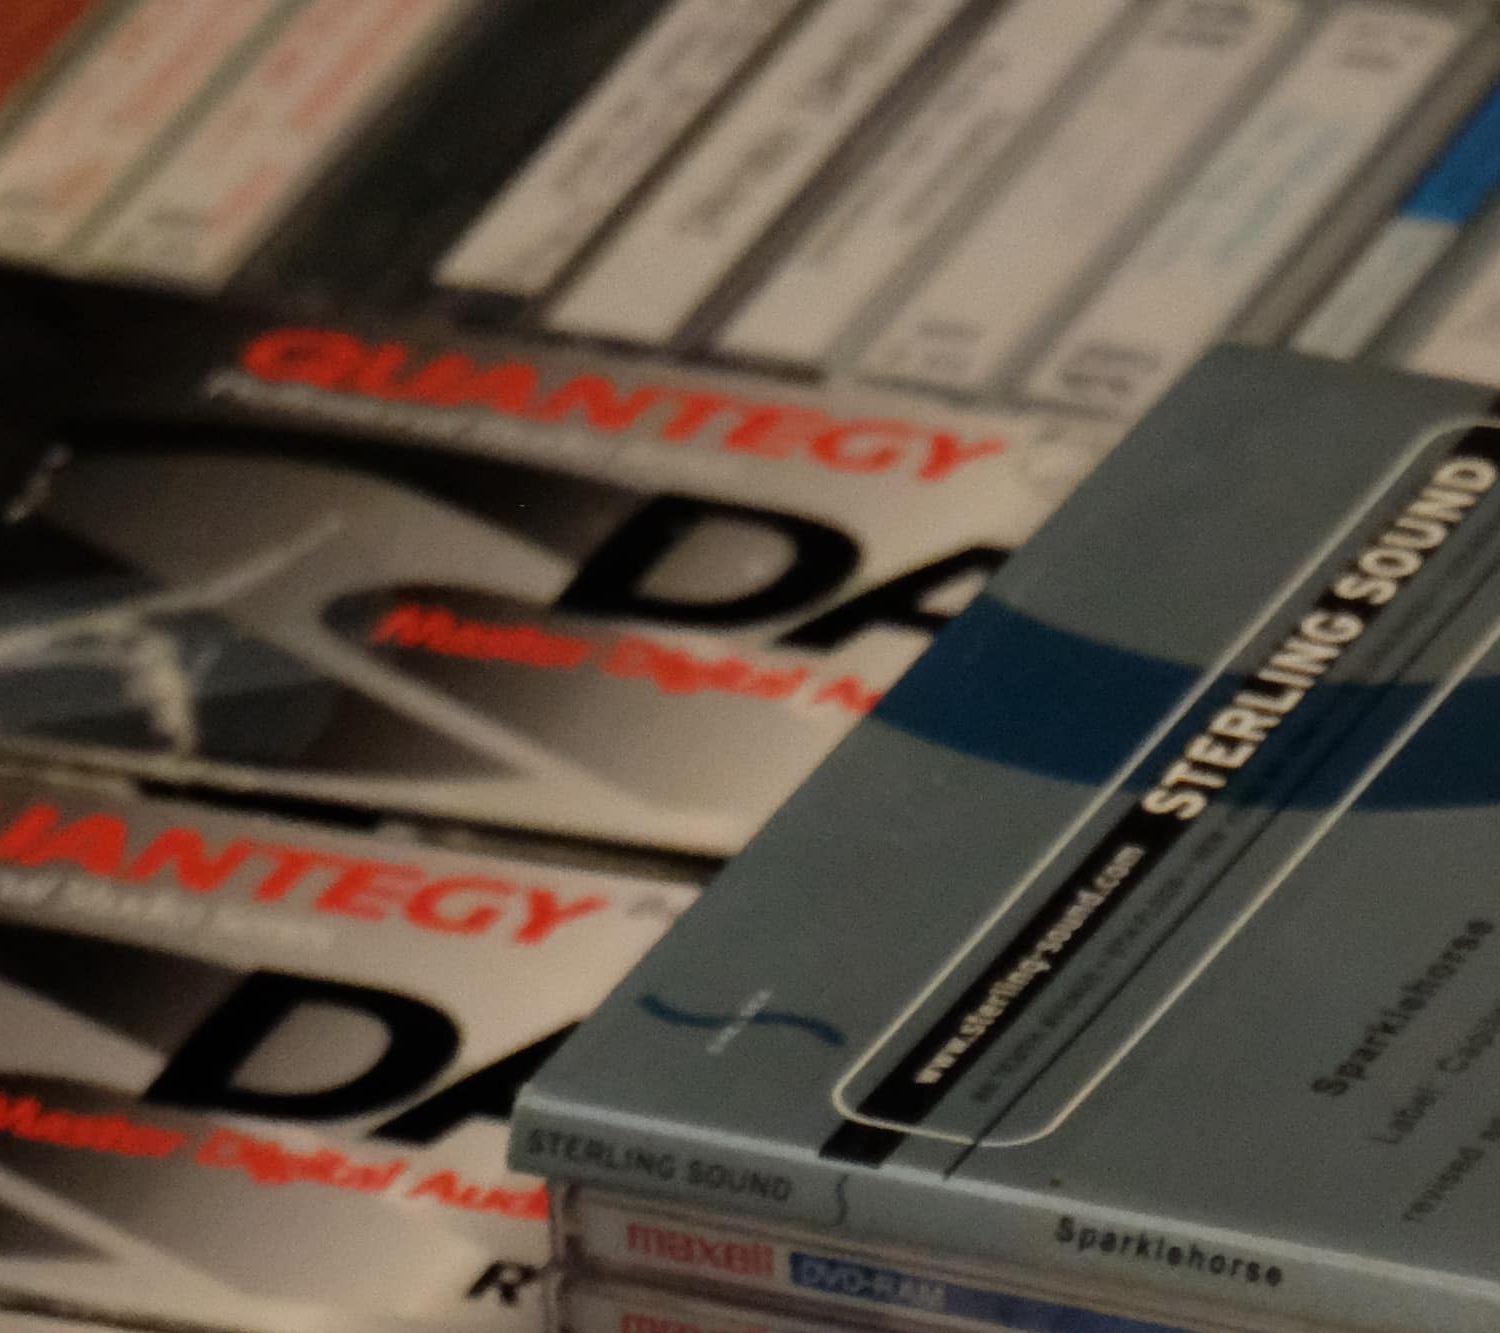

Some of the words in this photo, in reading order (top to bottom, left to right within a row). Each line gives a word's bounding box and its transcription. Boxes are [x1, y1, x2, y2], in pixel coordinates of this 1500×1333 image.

[242, 327, 1008, 483] QUANTEGY
[373, 603, 591, 670] Master
[1142, 609, 1366, 821] STERLING
[1333, 456, 1498, 605] SOUND
[913, 843, 1146, 1085] www.sterling-sound.com
[1310, 918, 1495, 1098] Sparklehorse
[195, 1125, 411, 1195] Digital
[527, 1128, 677, 1183] STERLING
[686, 1157, 795, 1203] SOUND
[1401, 1145, 1486, 1224] revised
[626, 1223, 776, 1278] maxell
[1053, 1213, 1286, 1289] Sparklehorse
